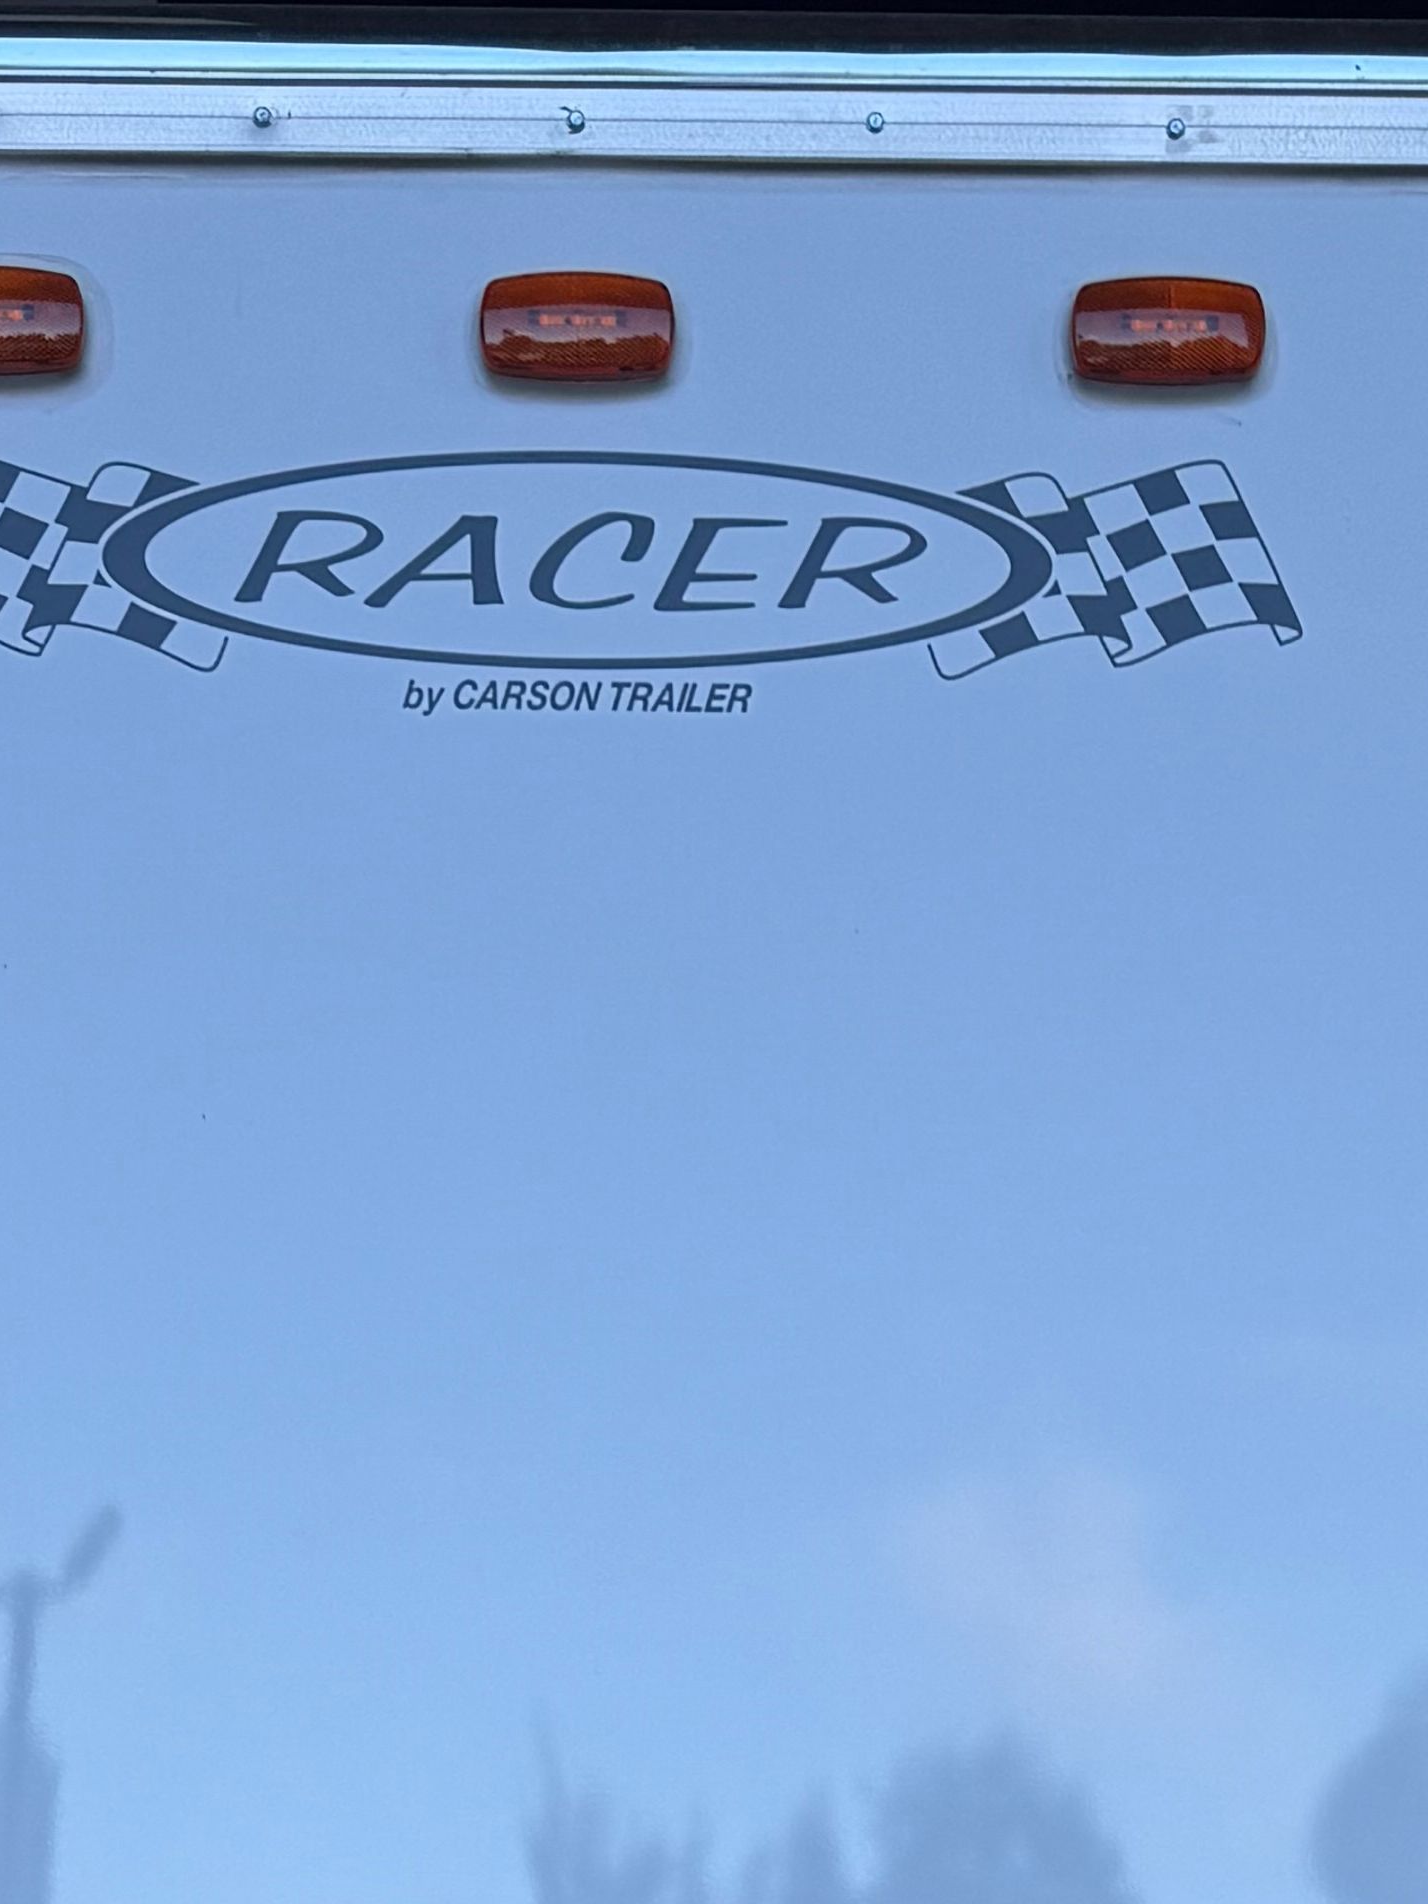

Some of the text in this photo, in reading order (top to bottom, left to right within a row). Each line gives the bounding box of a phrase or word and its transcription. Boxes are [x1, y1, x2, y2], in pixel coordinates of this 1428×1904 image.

[234, 511, 928, 611] RACER
[402, 679, 753, 716] by CARSON TRAILER
